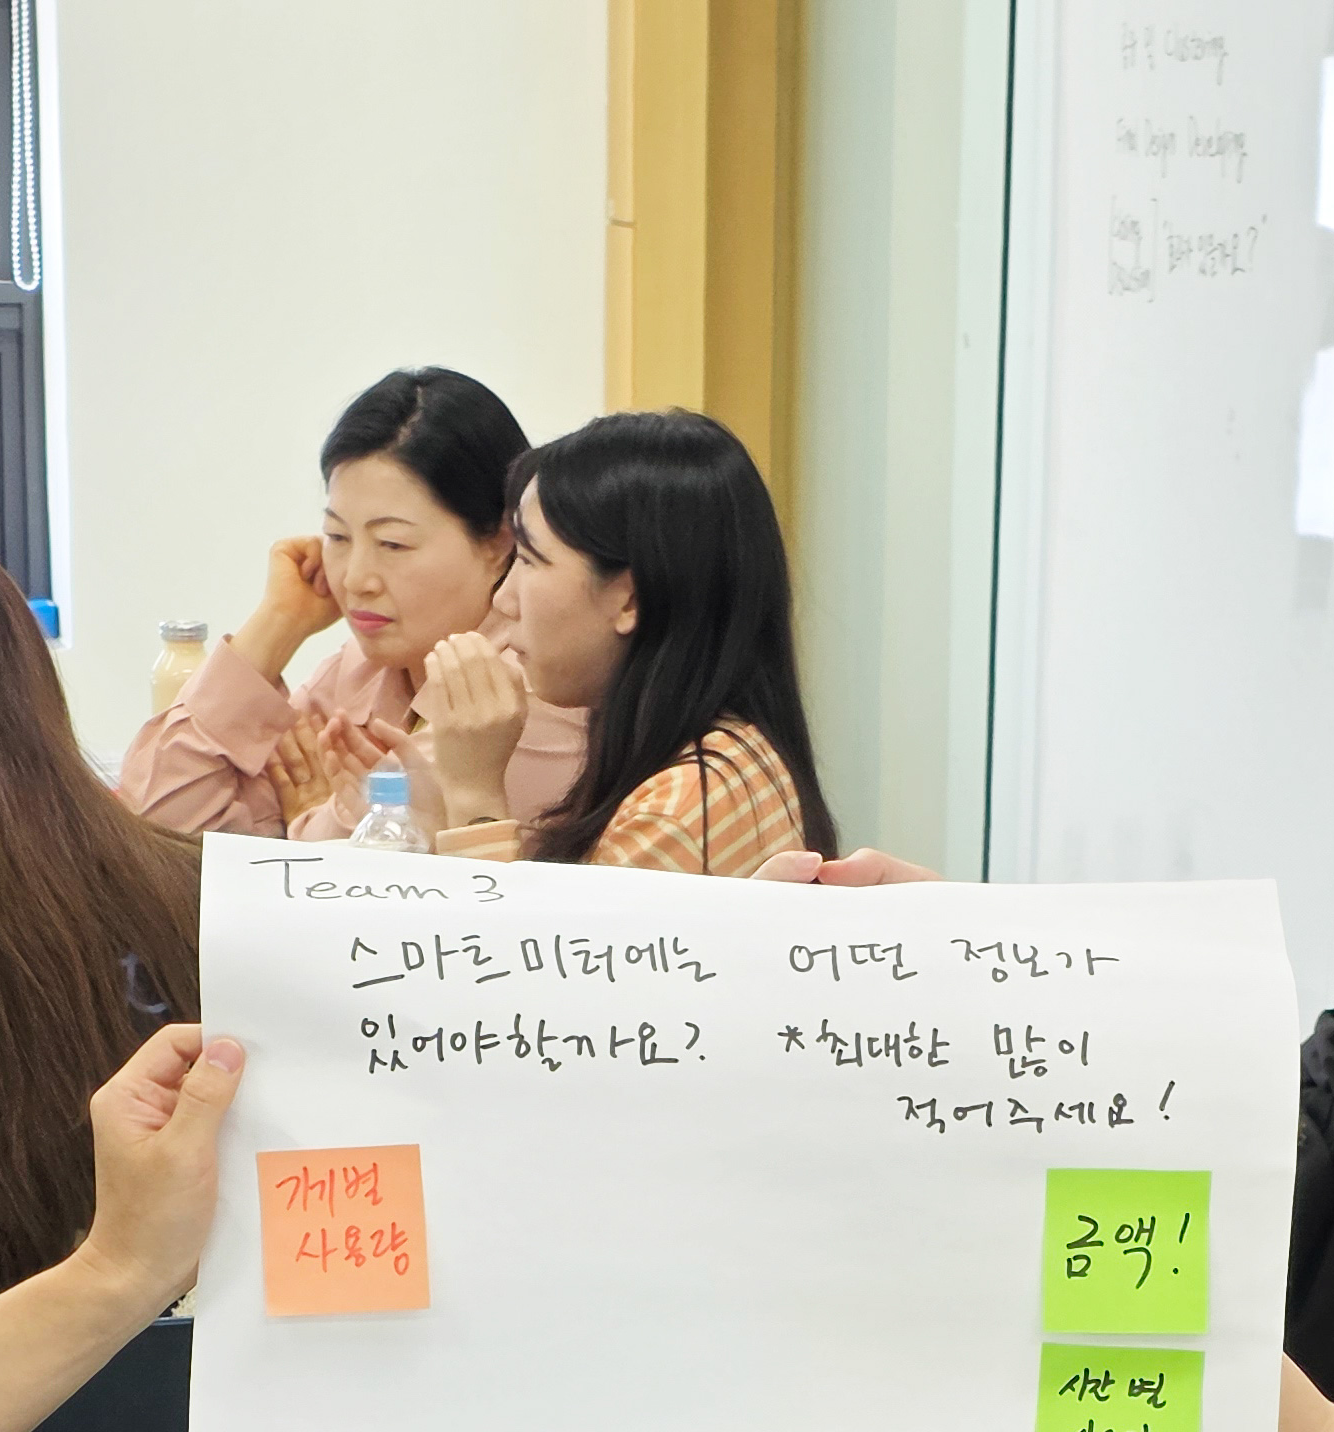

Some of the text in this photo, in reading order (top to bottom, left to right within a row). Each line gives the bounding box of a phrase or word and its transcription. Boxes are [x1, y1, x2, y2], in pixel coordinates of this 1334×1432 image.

[250, 858, 505, 903] Team 3
[789, 943, 918, 982] 어떤
[950, 938, 1119, 983] 정보가
[994, 1023, 1089, 1079] 많이
[295, 1221, 409, 1276] 사용량
